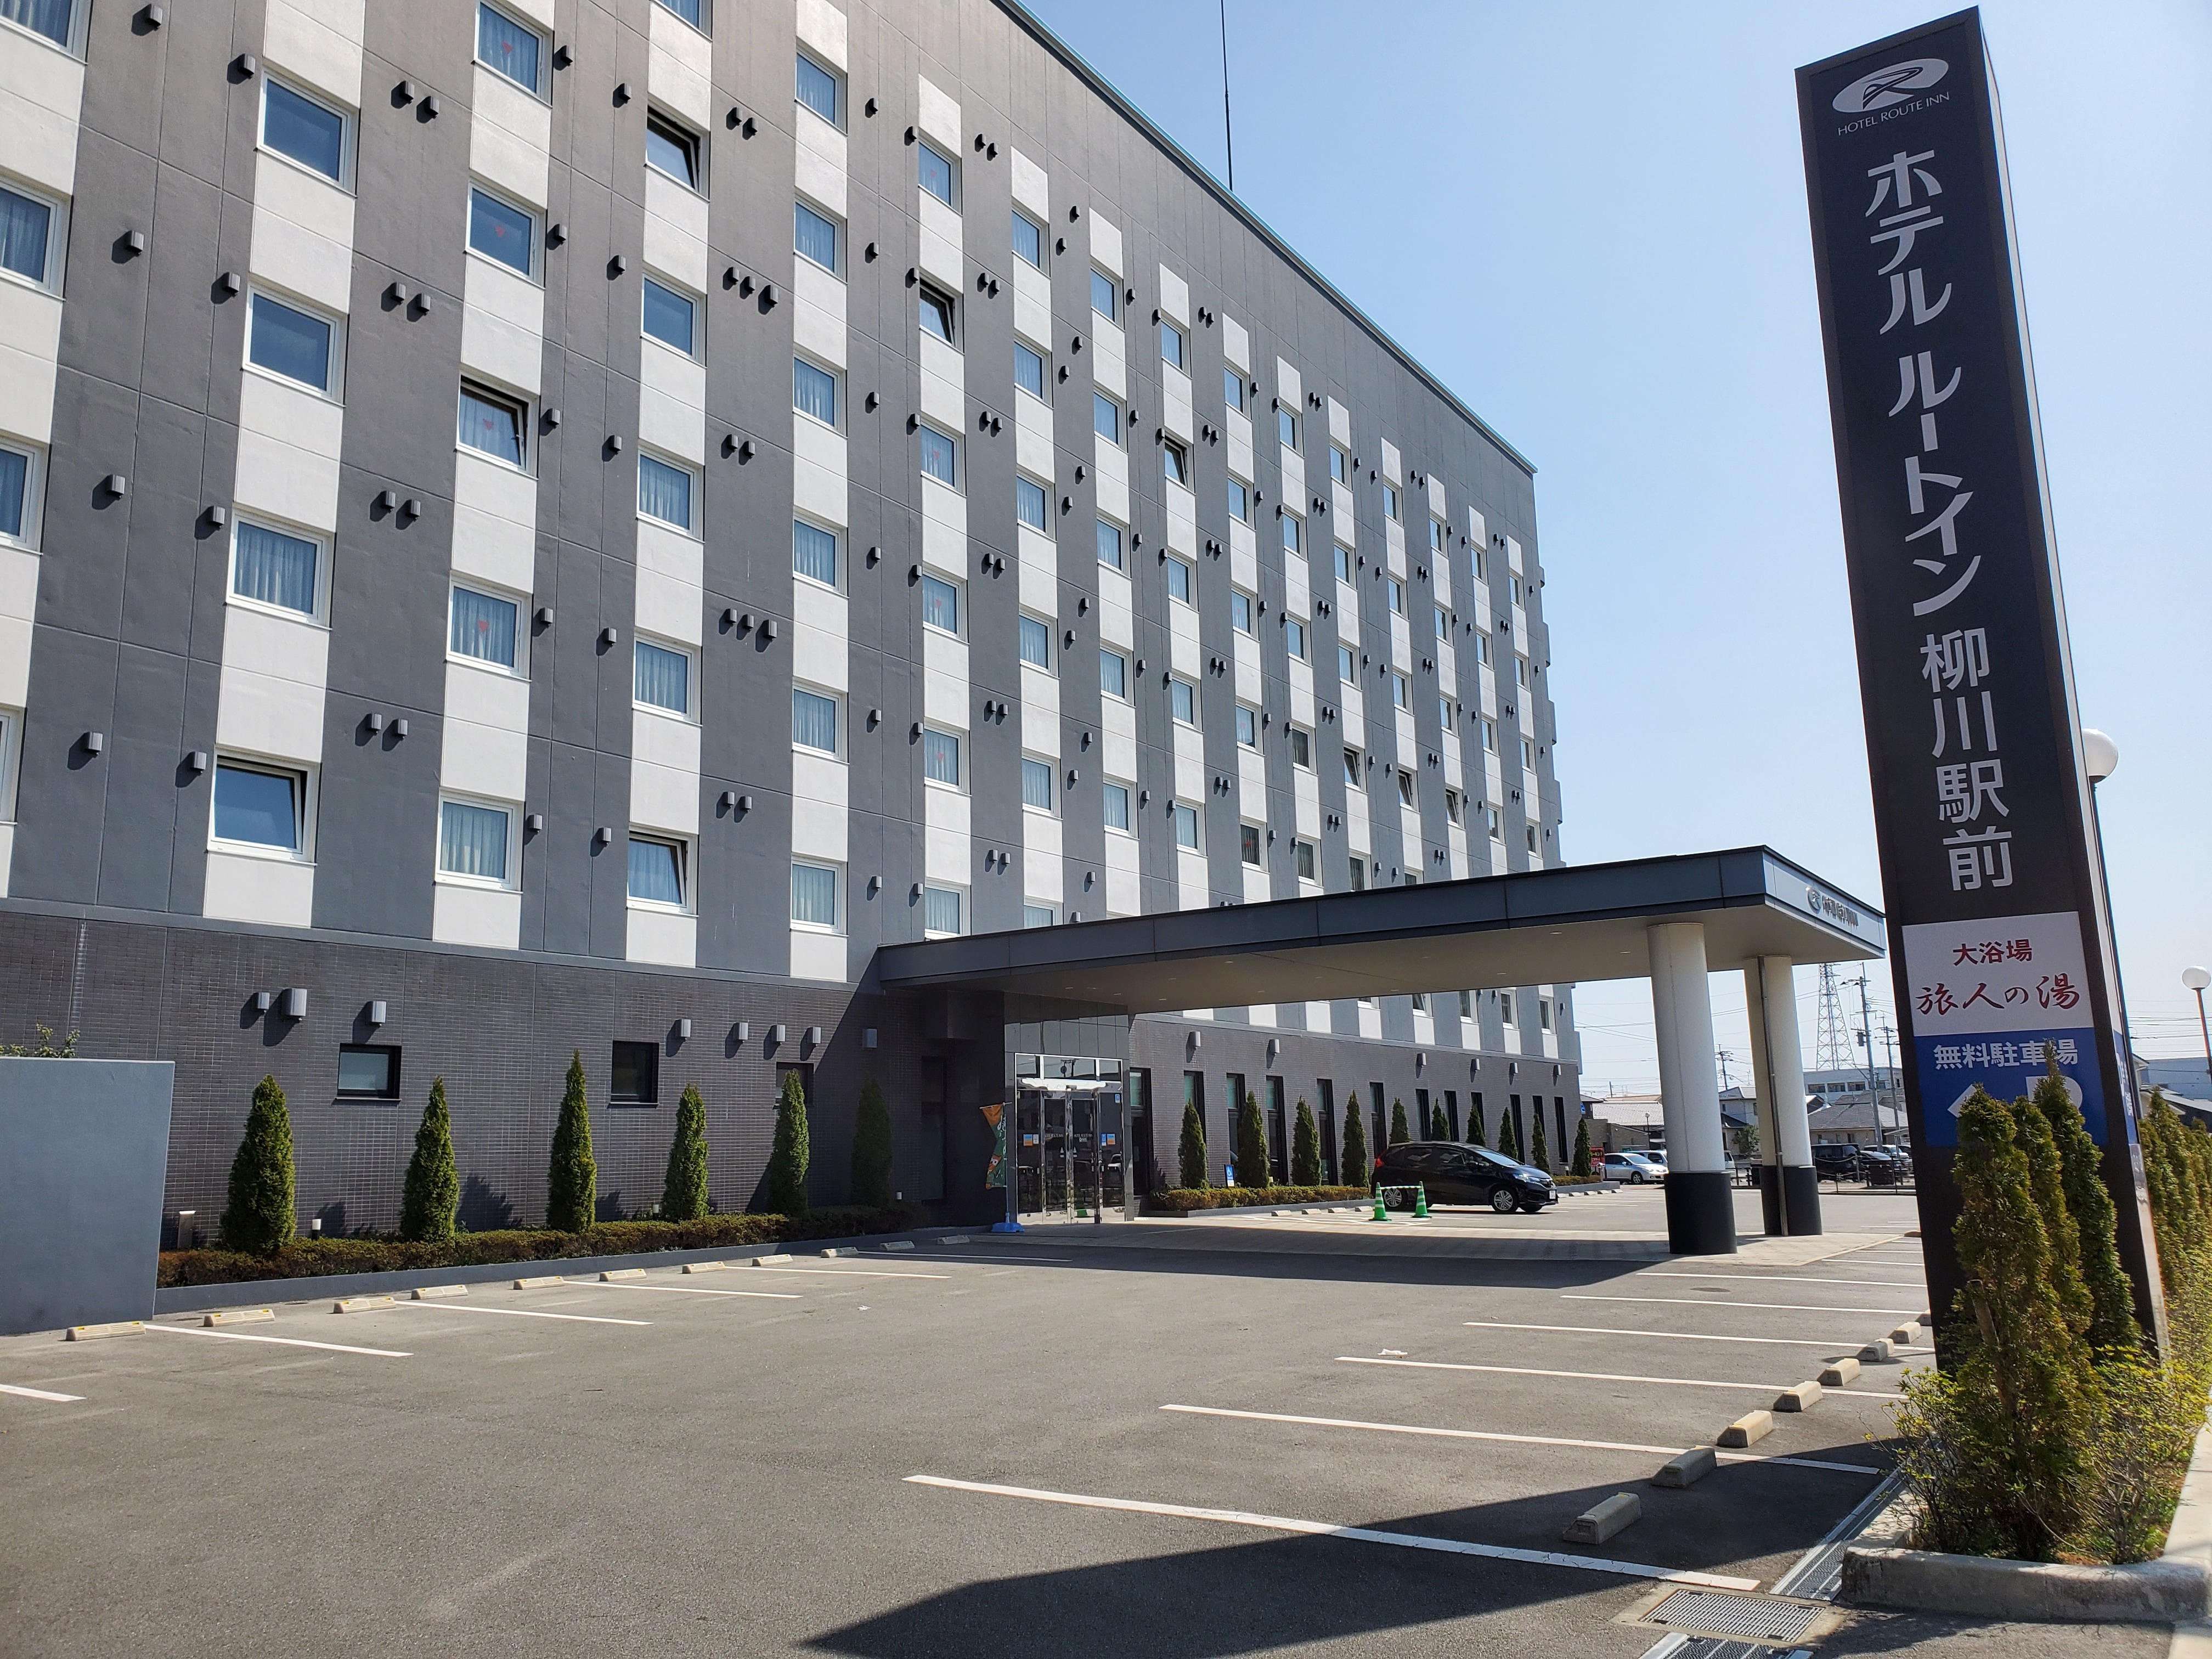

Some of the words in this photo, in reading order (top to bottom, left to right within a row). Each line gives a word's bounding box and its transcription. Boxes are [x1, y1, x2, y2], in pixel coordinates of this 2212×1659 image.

[1837, 116, 1878, 136] HOTEL
[1880, 100, 1923, 122] ROUTE
[1926, 91, 1950, 108] INN
[1865, 149, 2013, 891] ホテルルートイン柳川駅前
[1952, 938, 2033, 966] 大浴場
[1915, 972, 2080, 1015] 旅人の湯
[1933, 1038, 2079, 1070] 無料駐車場
